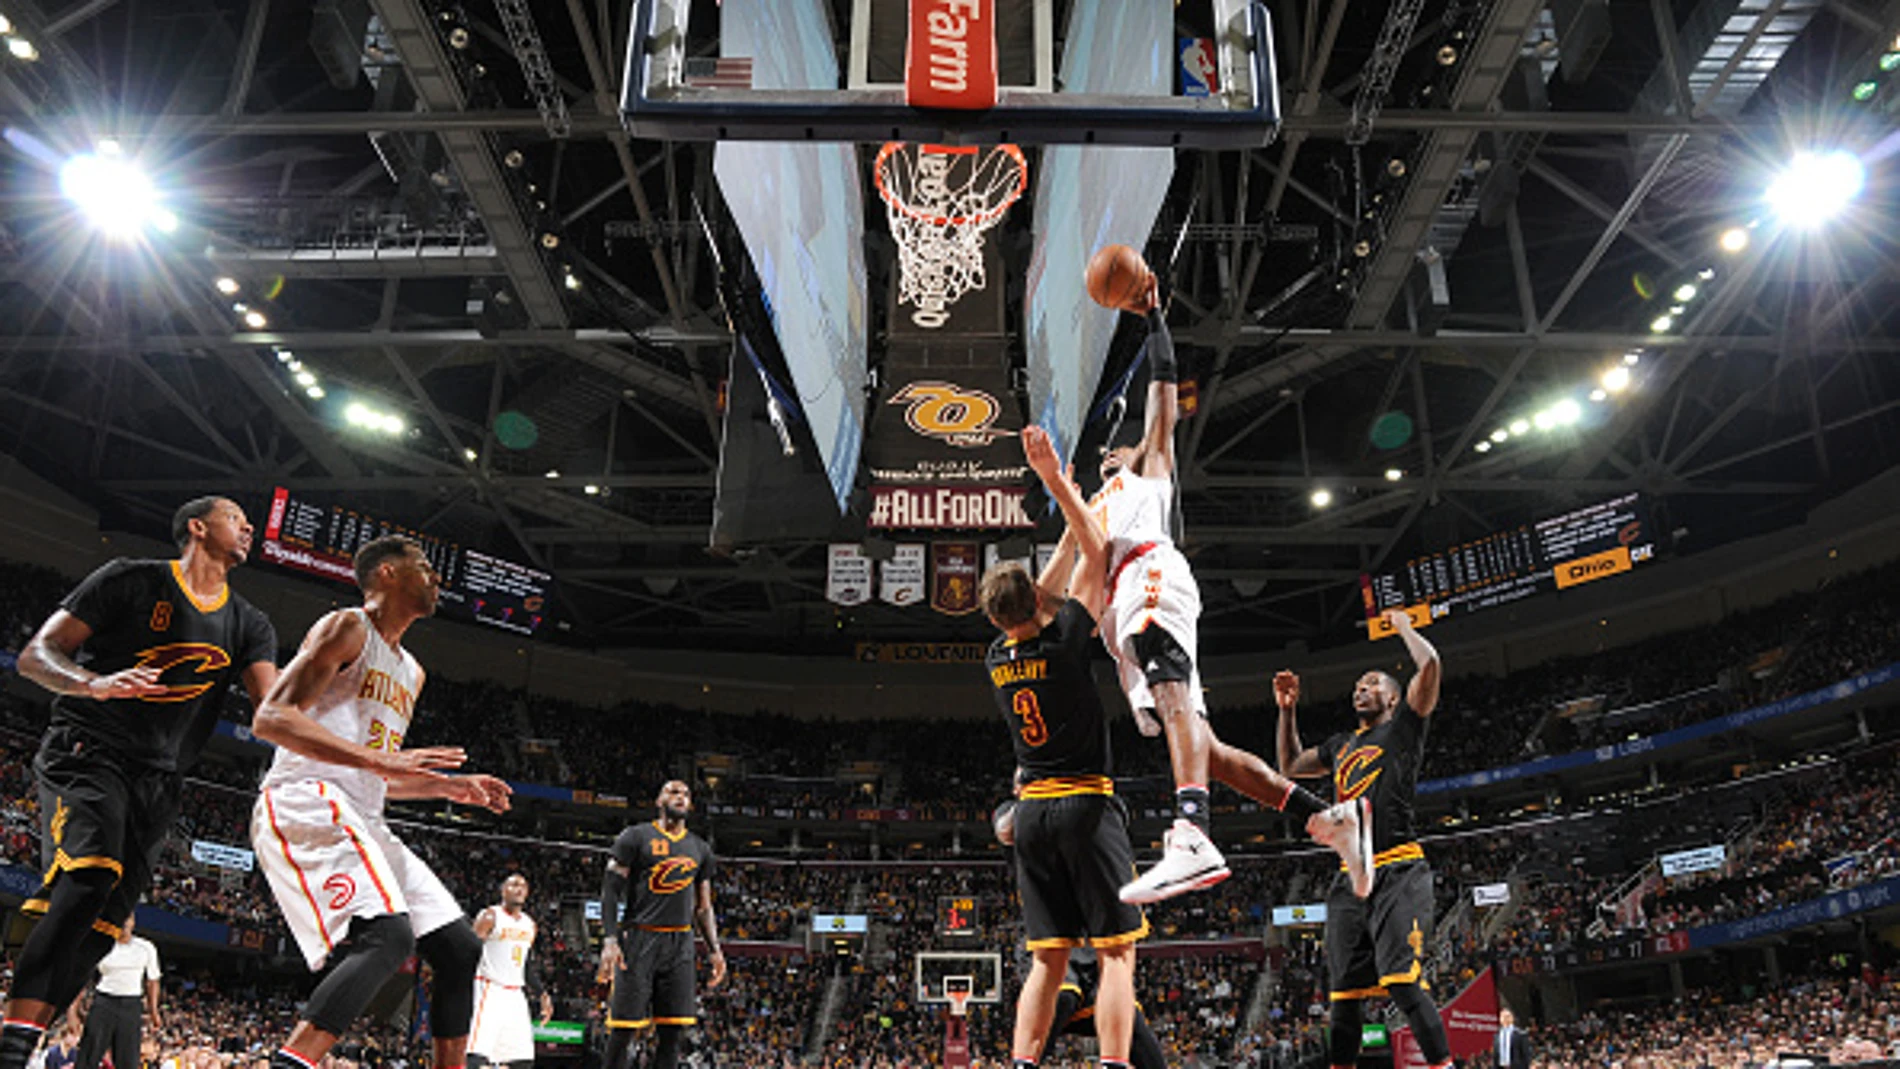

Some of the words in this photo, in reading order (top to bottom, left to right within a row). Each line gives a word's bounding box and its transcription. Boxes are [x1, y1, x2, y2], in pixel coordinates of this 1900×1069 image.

[926, 0, 980, 92] Farm
[149, 600, 174, 632] 8
[1012, 687, 1049, 747] 3
